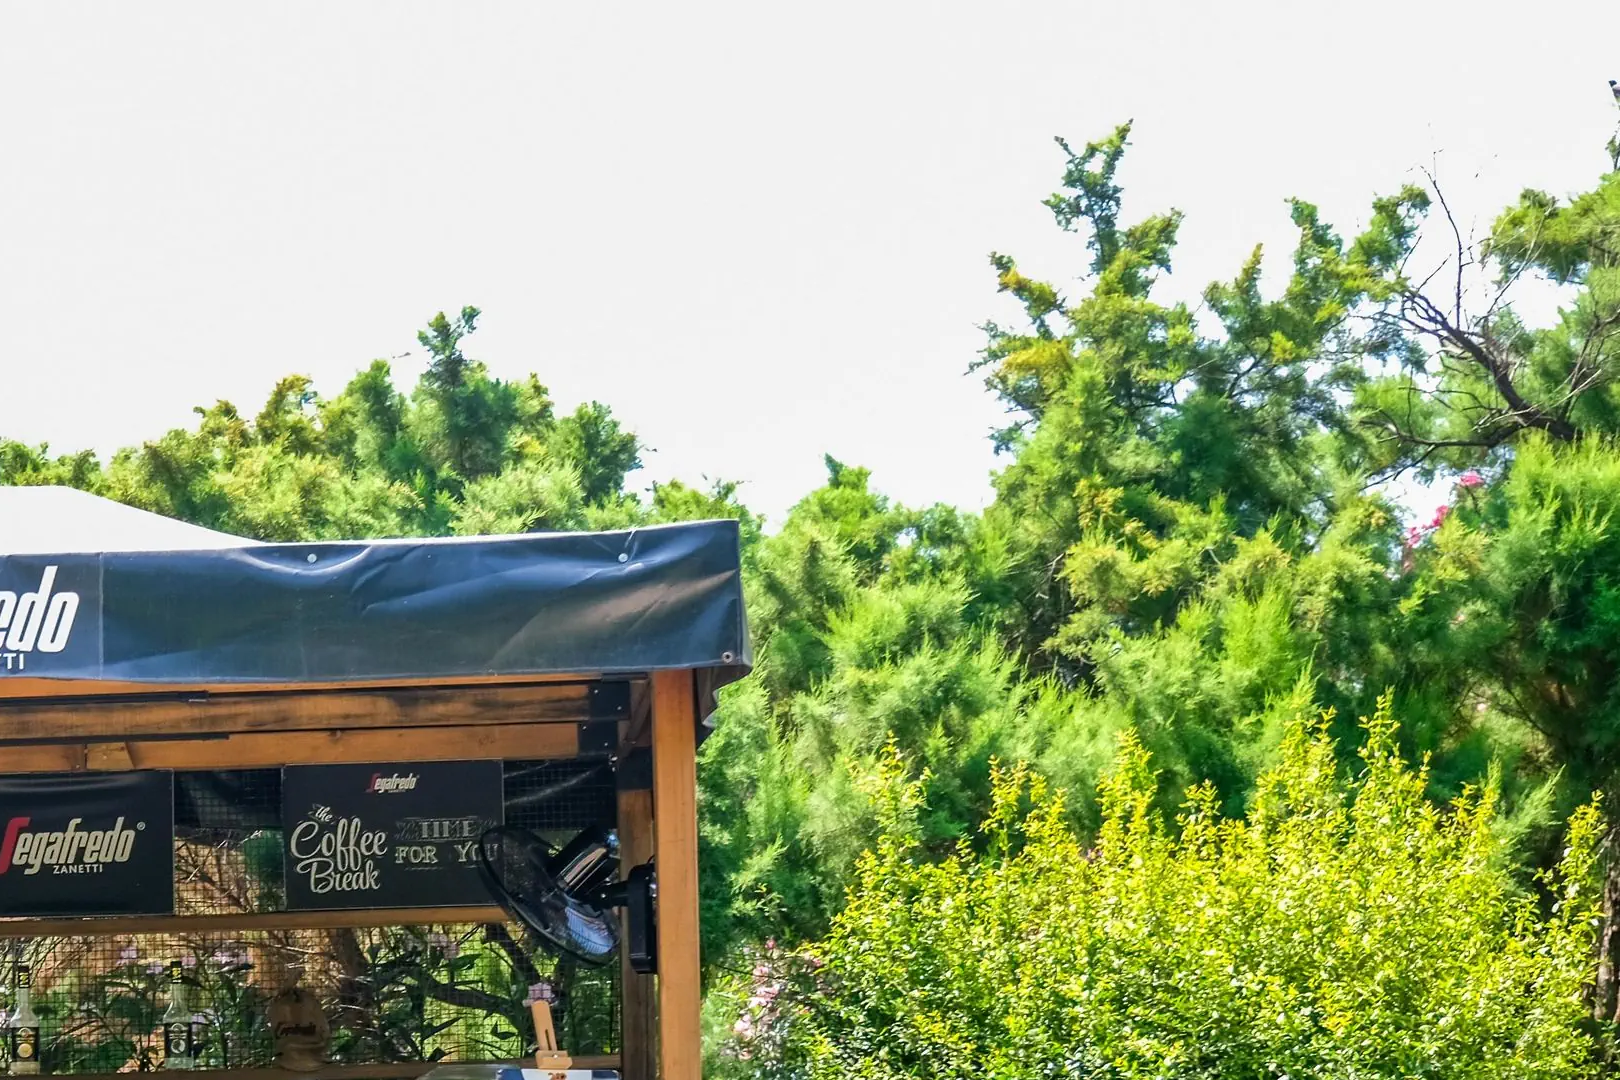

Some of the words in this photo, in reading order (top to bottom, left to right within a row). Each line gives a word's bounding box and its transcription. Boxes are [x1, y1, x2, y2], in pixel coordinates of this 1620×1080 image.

[365, 773, 417, 793] Segafredo
[315, 806, 332, 822] the
[420, 820, 476, 838] TIME
[291, 817, 388, 872] Coffee
[394, 845, 439, 864] FOR
[53, 863, 103, 875] ZANETTI
[296, 857, 380, 894] Break
